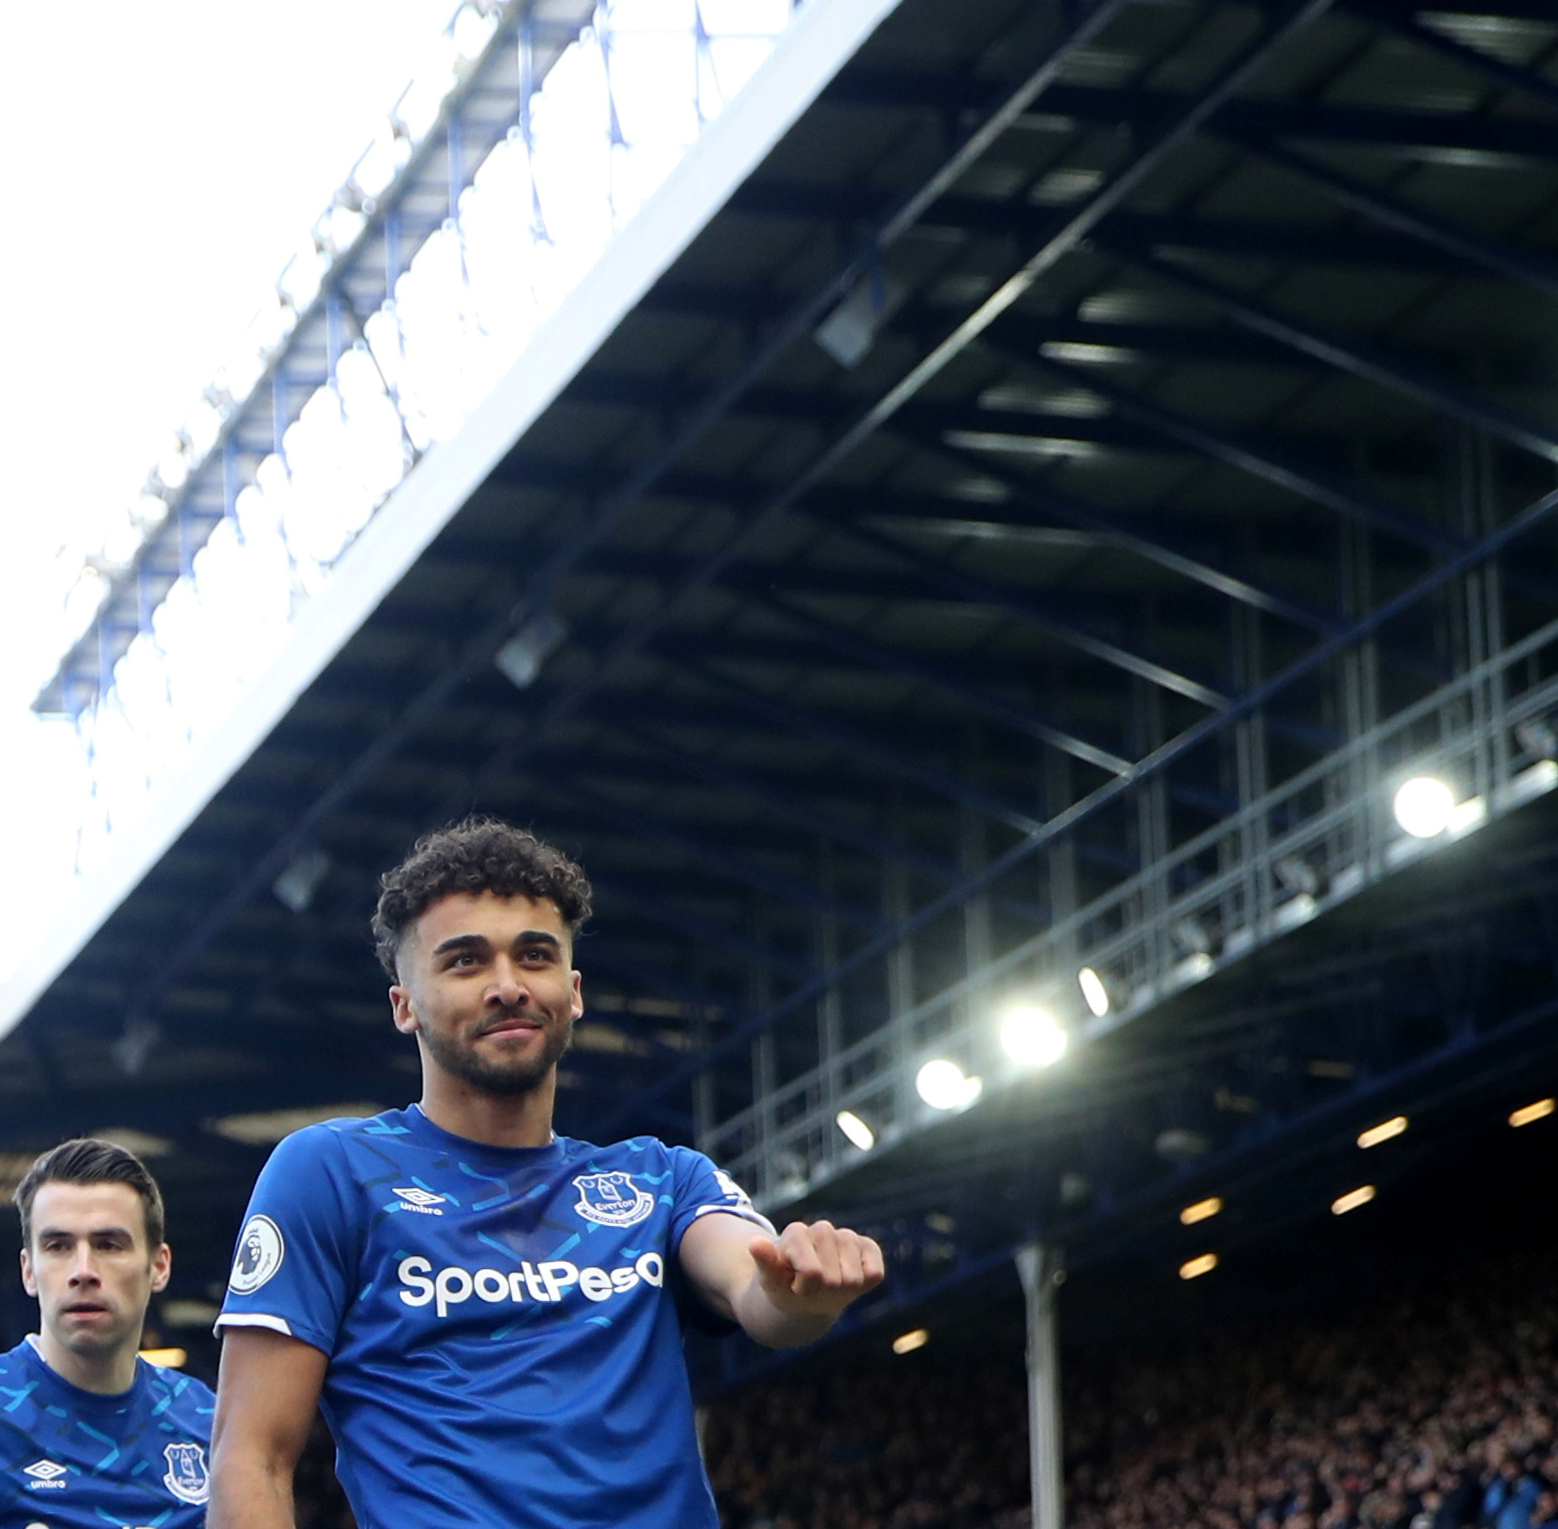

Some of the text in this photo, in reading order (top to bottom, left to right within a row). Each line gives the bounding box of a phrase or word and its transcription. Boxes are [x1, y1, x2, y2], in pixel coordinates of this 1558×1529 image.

[399, 1201, 444, 1216] umbro
[397, 1251, 664, 1318] SportPesa
[30, 1478, 66, 1489] umbro
